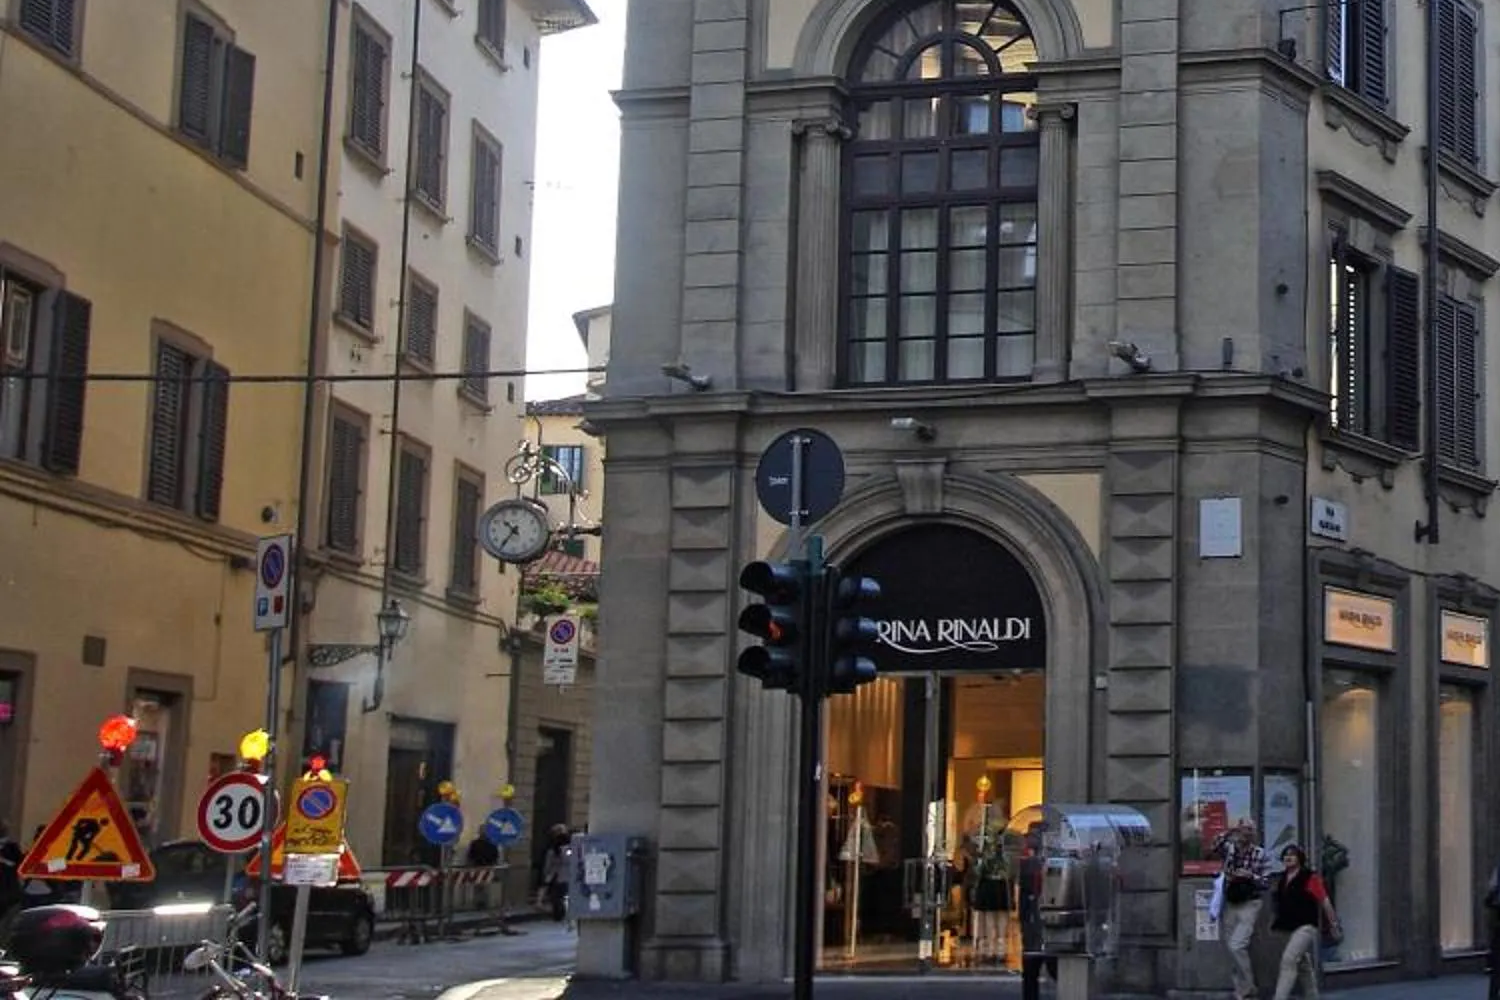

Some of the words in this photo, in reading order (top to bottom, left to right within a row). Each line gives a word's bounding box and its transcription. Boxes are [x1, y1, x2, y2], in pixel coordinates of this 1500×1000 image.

[876, 619, 932, 652] RINA
[937, 617, 1031, 650] RINALDI
[213, 795, 260, 830] 30
